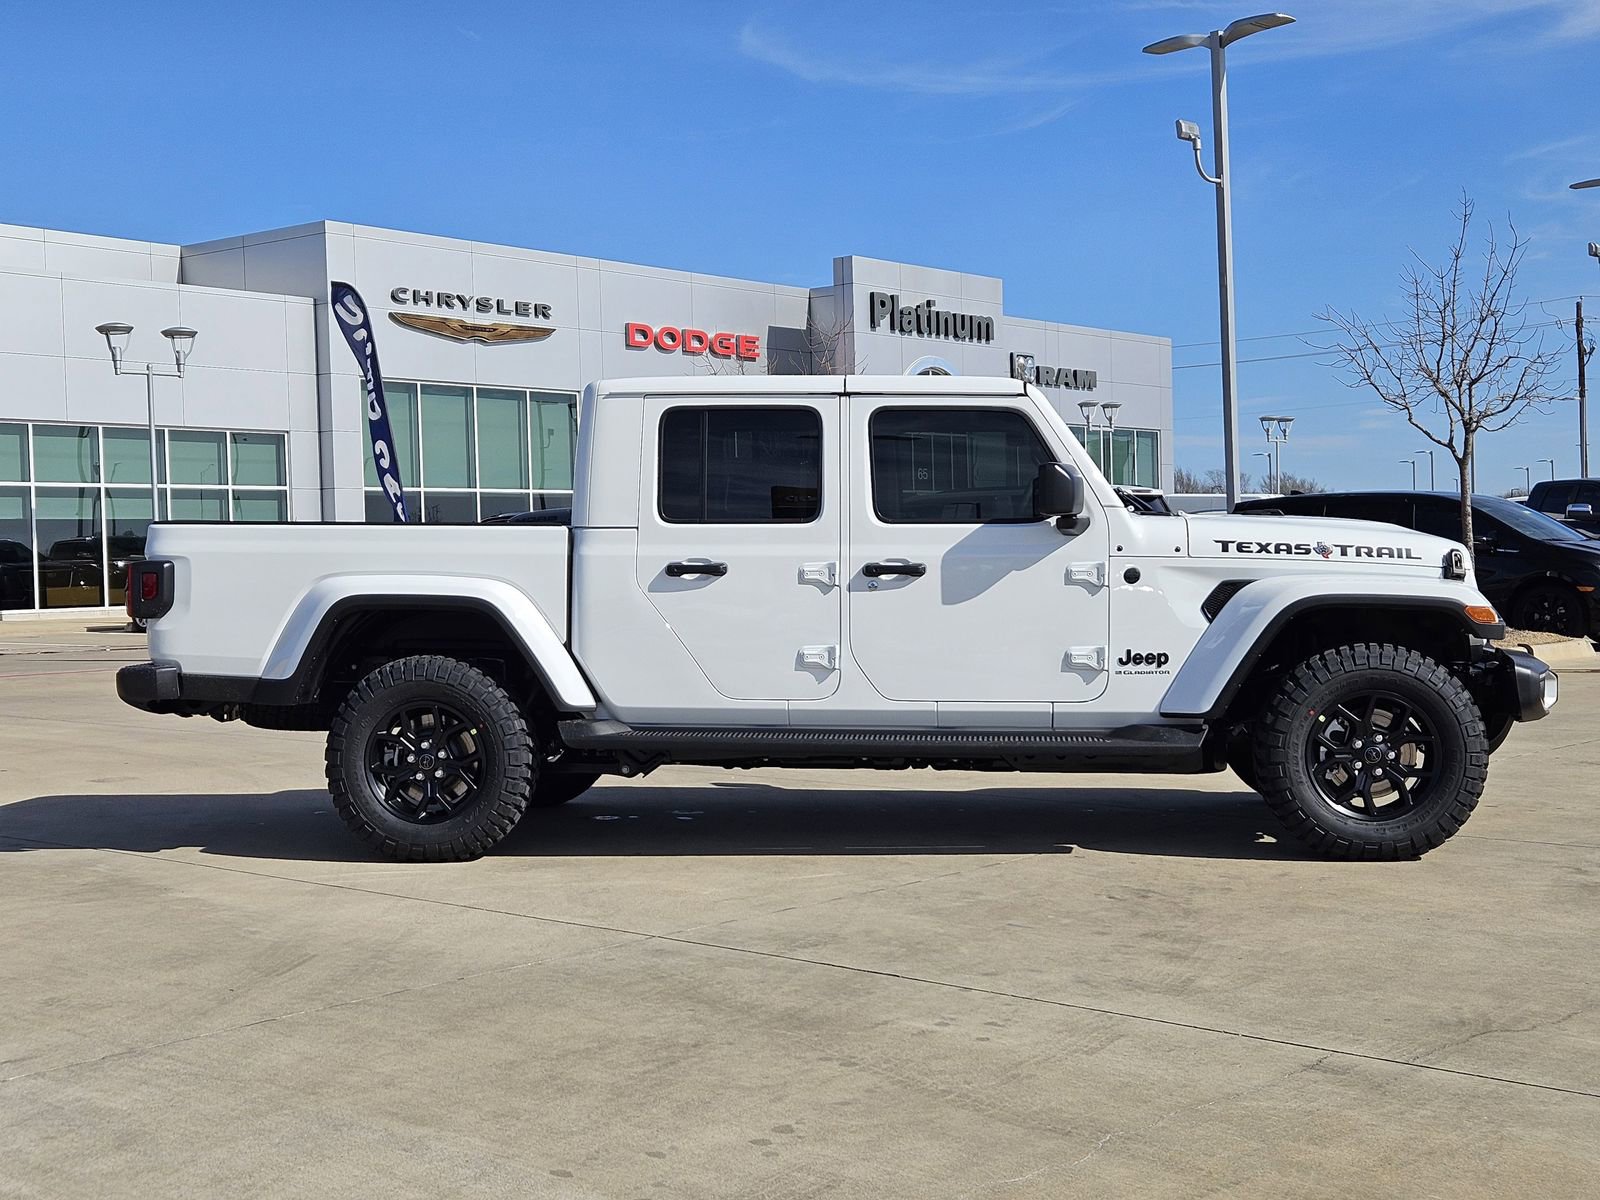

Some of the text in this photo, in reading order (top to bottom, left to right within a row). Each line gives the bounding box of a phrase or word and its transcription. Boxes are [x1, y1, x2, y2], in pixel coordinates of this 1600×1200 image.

[390, 287, 552, 321] CHRYSLER
[869, 291, 995, 345] Platinum
[624, 322, 761, 362] DODGE
[1035, 365, 1097, 392] RAM
[1212, 539, 1423, 560] TEXAS TRAIL
[1117, 648, 1170, 669] Jeep
